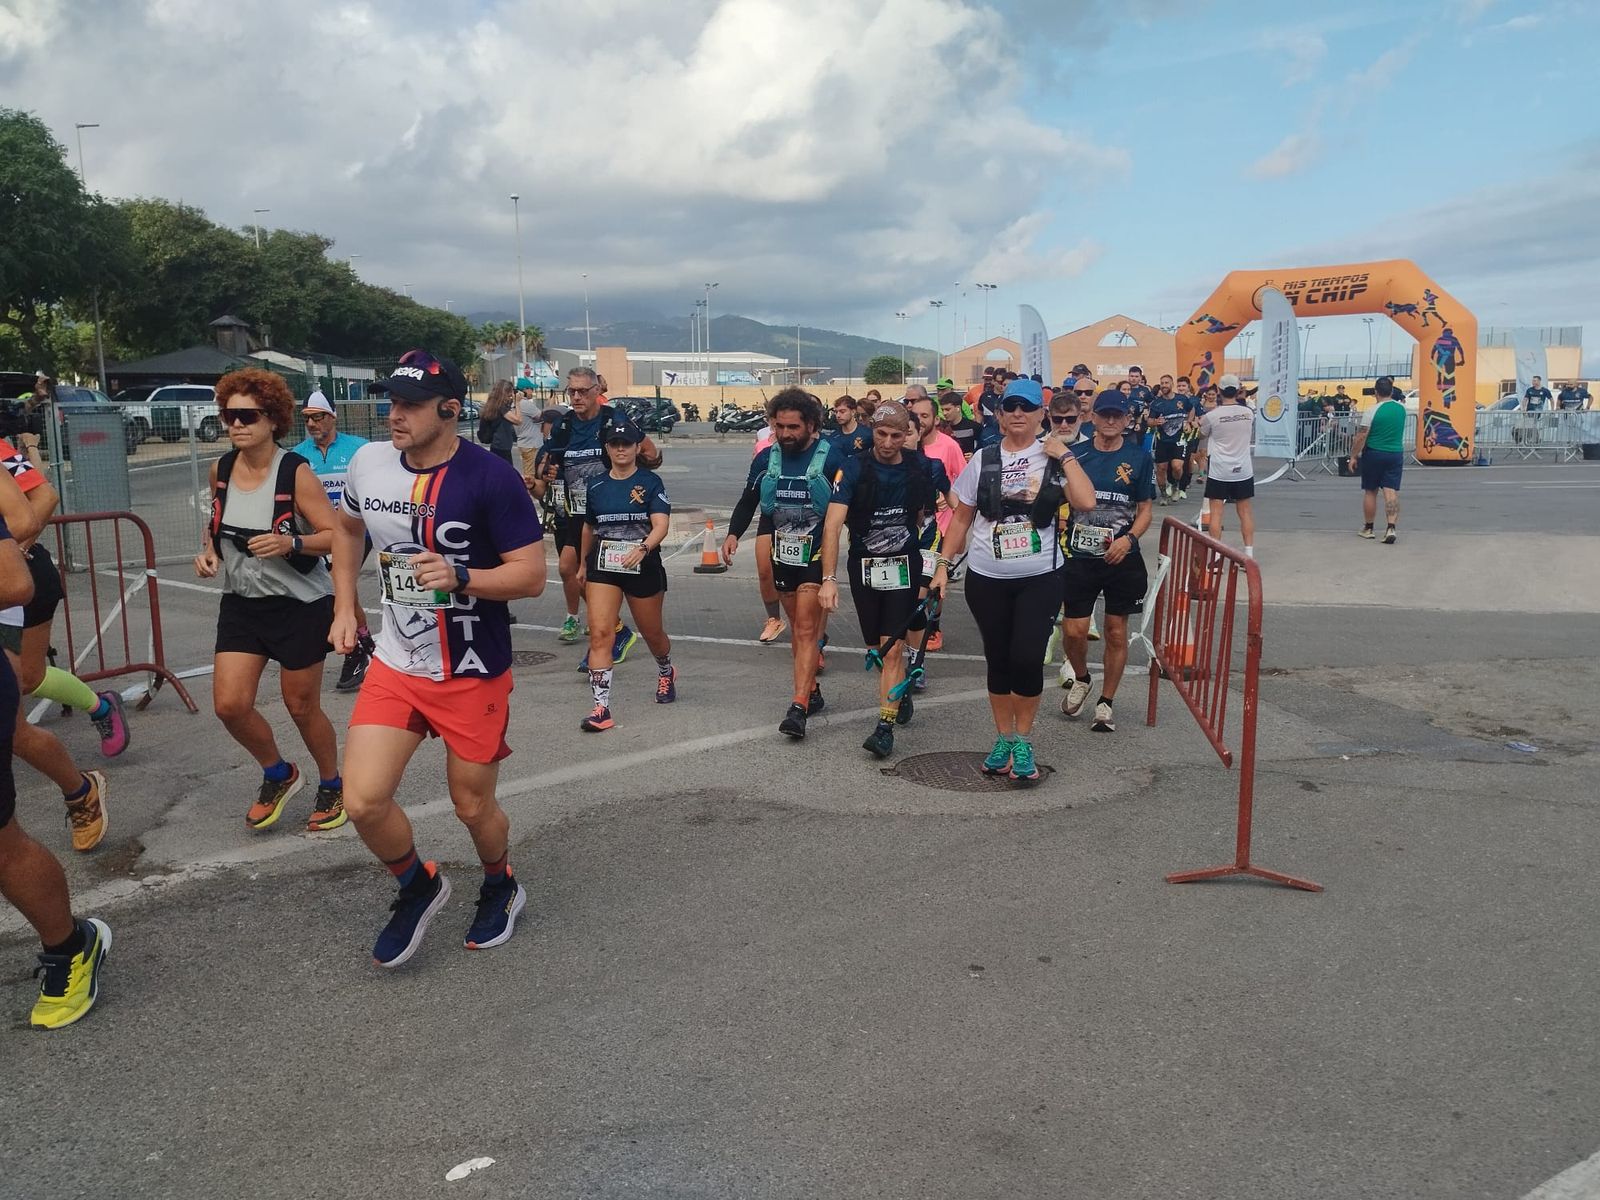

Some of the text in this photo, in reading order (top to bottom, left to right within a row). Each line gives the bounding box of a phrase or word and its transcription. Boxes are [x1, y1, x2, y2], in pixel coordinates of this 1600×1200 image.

[1282, 272, 1370, 291] MIS TIEMPOS
[1305, 283, 1368, 304] CHIP
[364, 497, 436, 518] BOMBEROS
[1003, 536, 1029, 550] 118
[1080, 536, 1101, 547] 235
[781, 544, 801, 557] 168
[881, 570, 889, 581] 1
